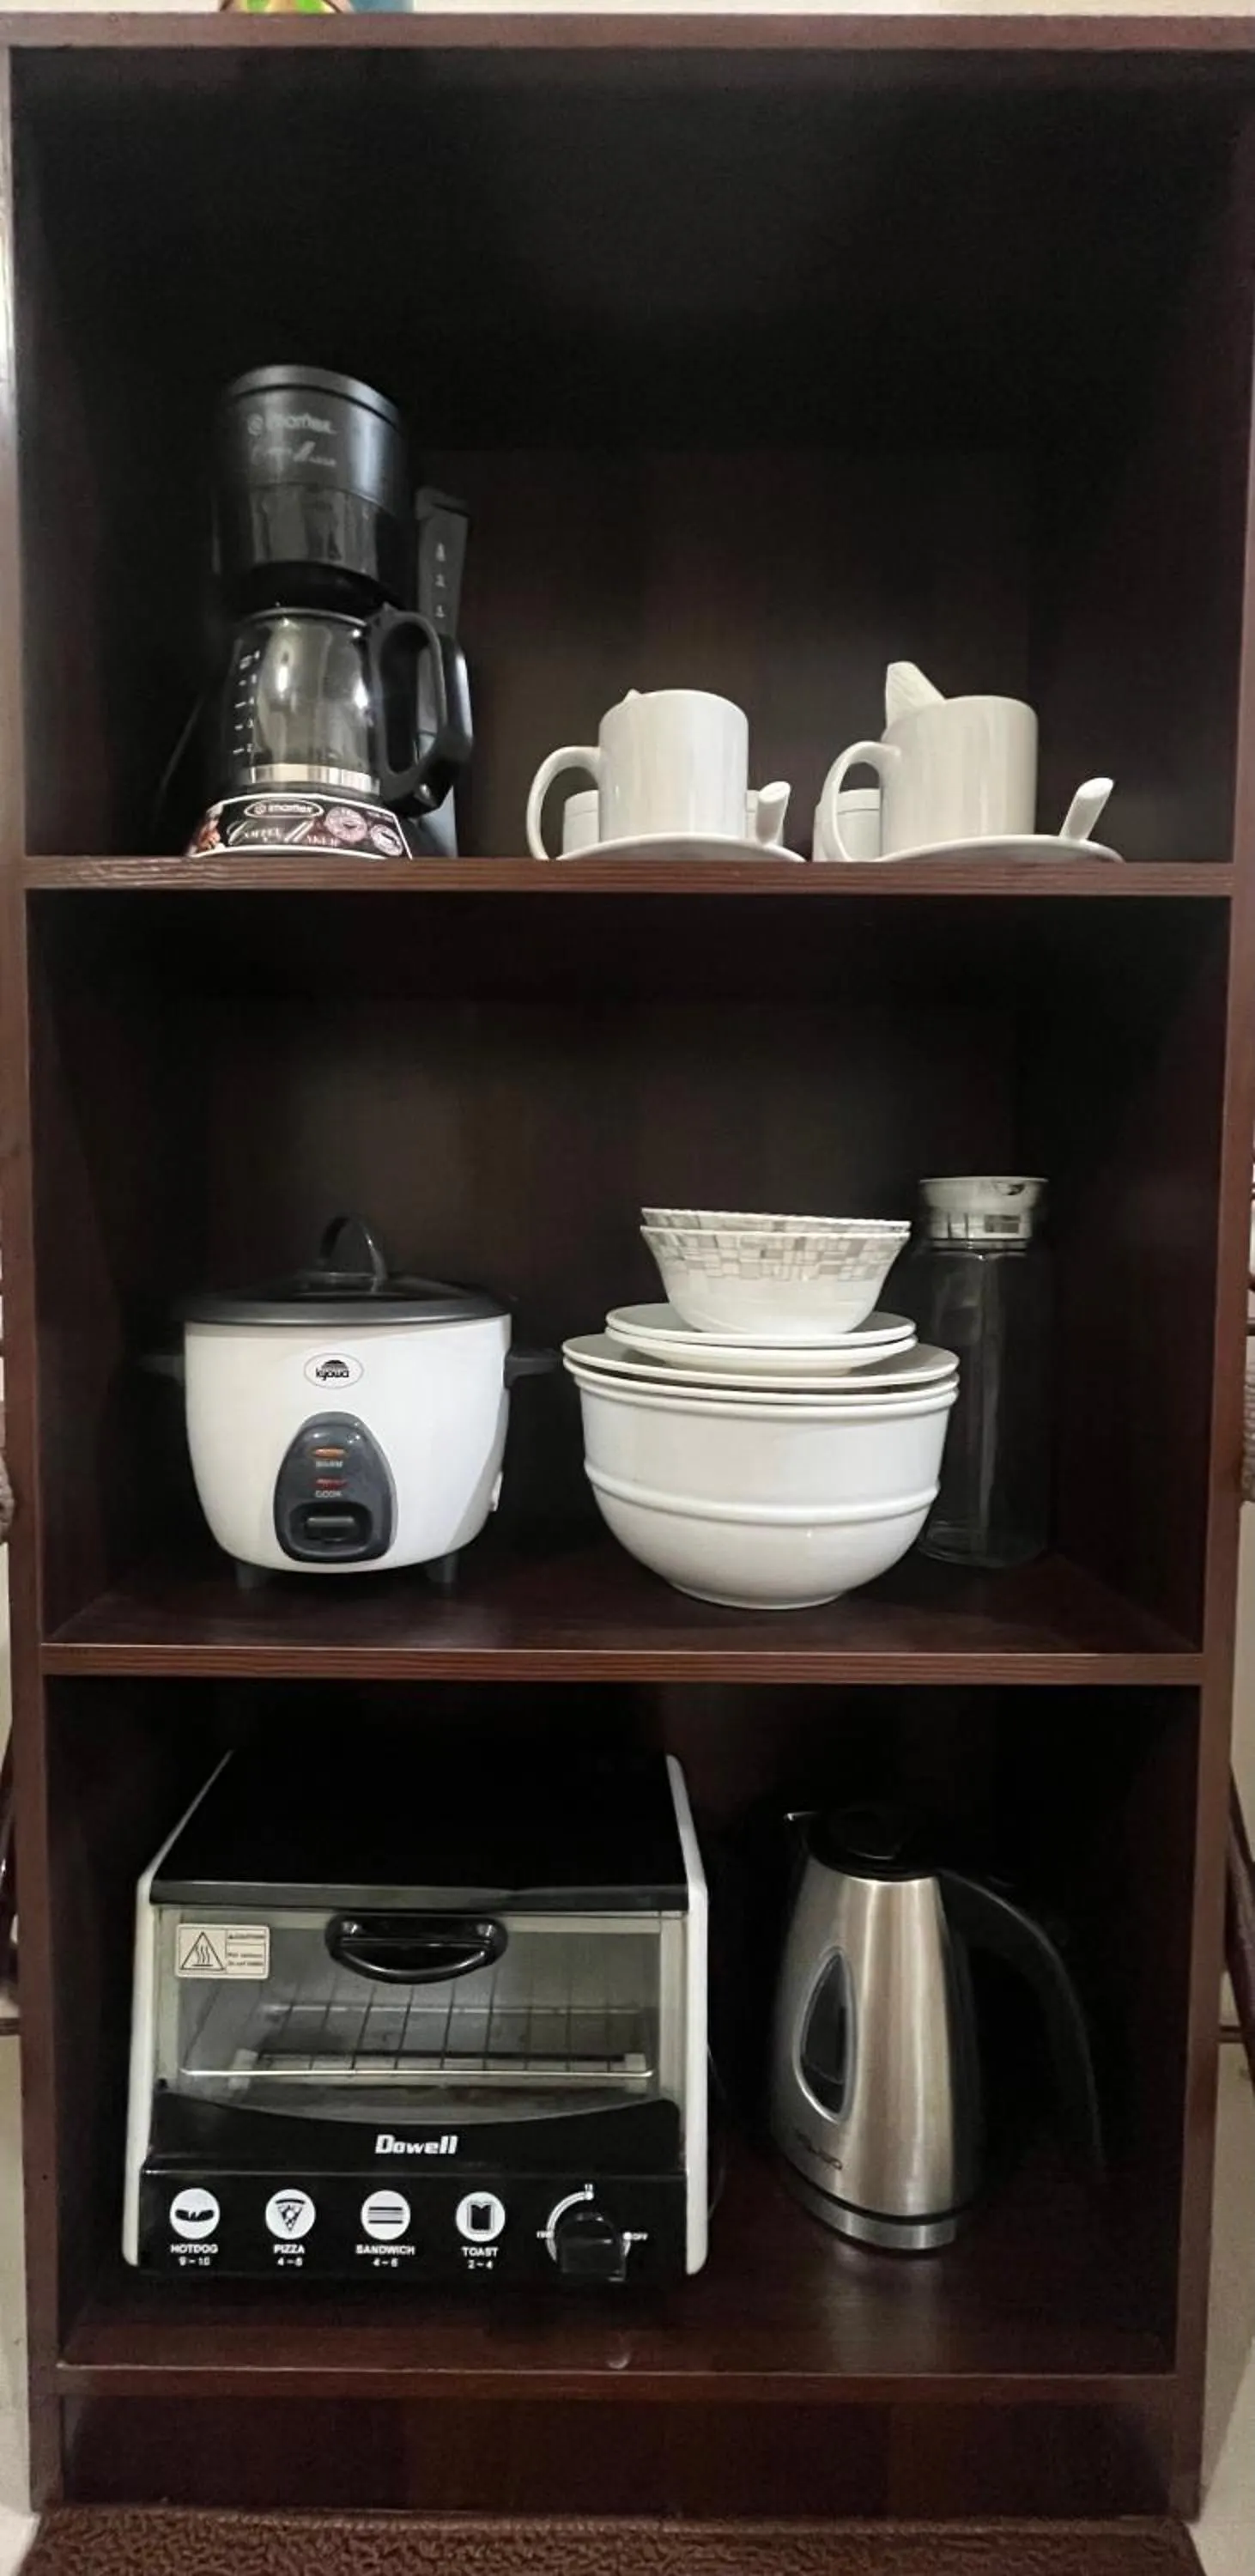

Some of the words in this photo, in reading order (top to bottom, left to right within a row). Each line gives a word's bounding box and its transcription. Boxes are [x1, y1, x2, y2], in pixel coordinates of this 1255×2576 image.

[374, 2134, 458, 2154] Dowell
[170, 2243, 219, 2254] HOTDOG
[274, 2243, 306, 2254] PIZZA
[355, 2244, 415, 2256] SANDWICH
[461, 2245, 499, 2257] TOAST
